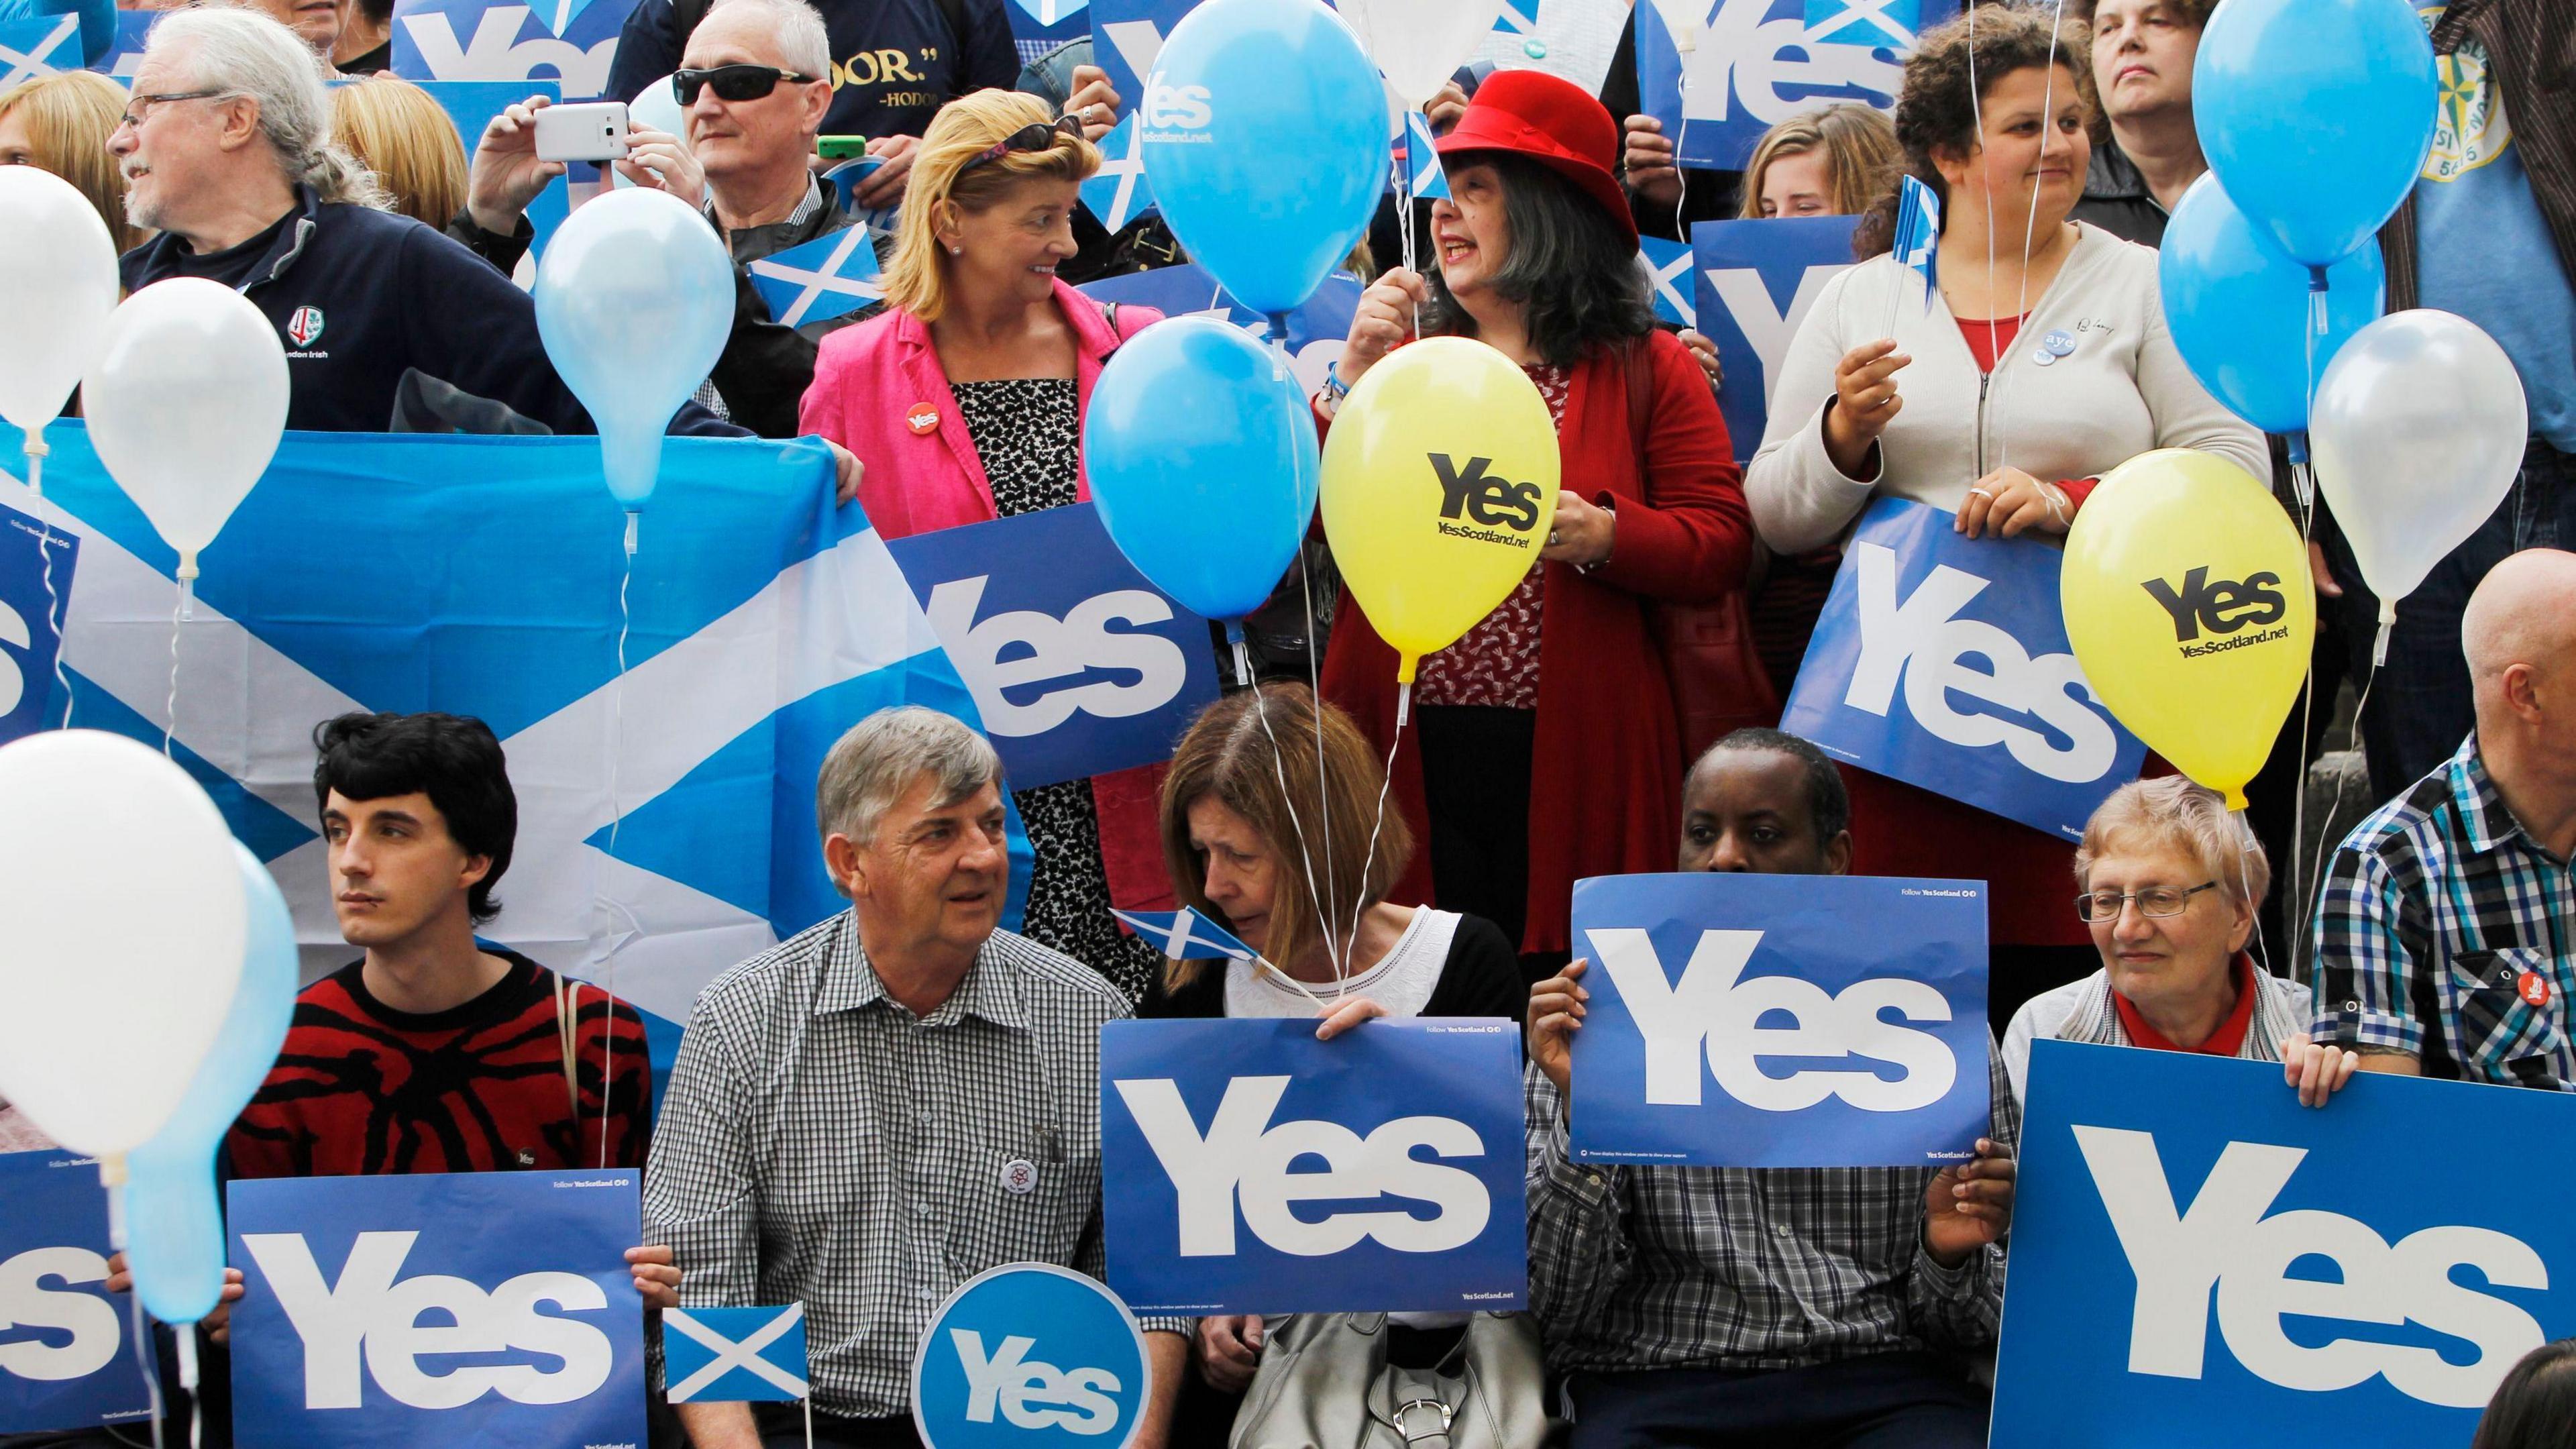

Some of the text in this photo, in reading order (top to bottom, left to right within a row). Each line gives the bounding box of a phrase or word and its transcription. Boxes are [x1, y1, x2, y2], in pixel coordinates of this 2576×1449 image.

[2045, 335, 2076, 347] aye
[907, 411, 938, 430] Yes
[1428, 452, 1542, 532] Yes
[1438, 521, 1530, 549] YesScotland.net
[2141, 566, 2286, 641] Yes
[1844, 541, 2117, 783] Yes
[2178, 625, 2289, 659] YesScotland.net
[1584, 928, 1957, 1112] Yes
[2527, 976, 2542, 1000] Yes
[519, 1152, 535, 1165] Yes
[1113, 1075, 1491, 1257] Yes
[1462, 1292, 1514, 1300] YesScotland.net
[2070, 1124, 2549, 1409] Yes
[241, 1230, 613, 1409] Yes
[950, 1328, 1122, 1436] Yes
